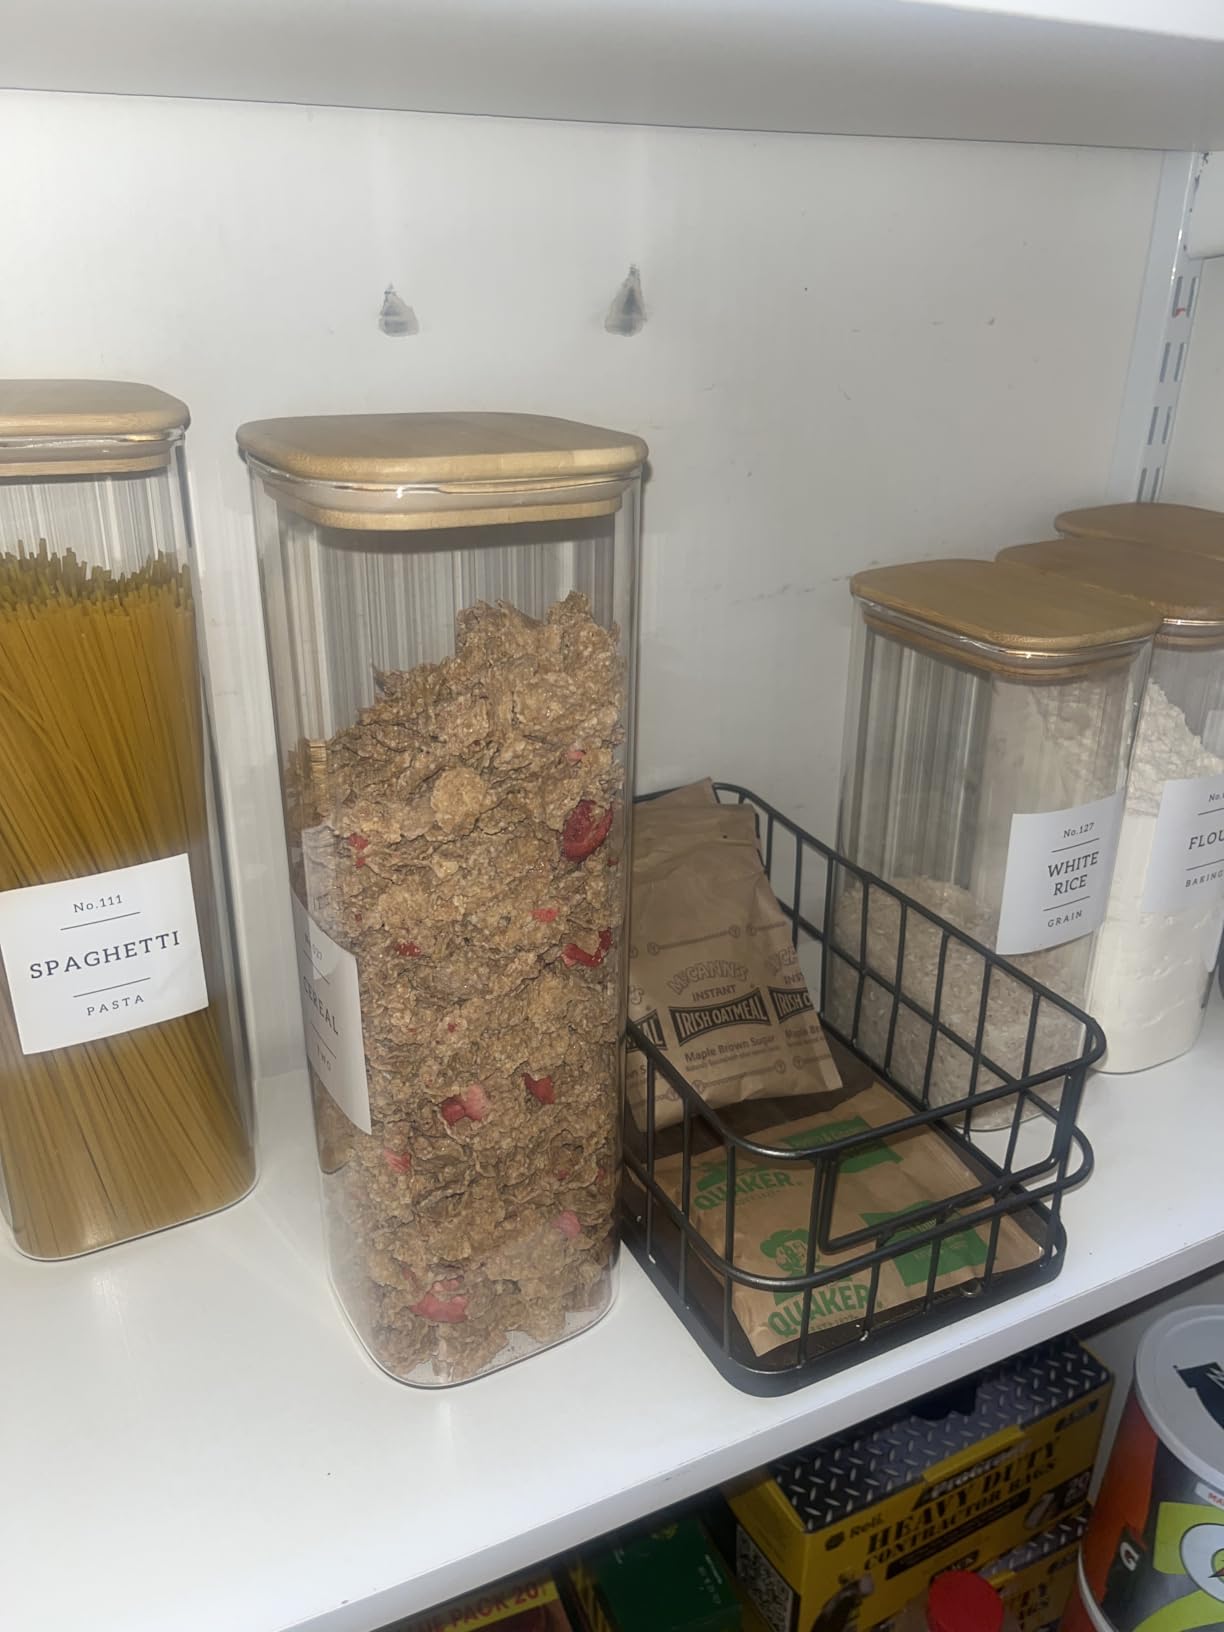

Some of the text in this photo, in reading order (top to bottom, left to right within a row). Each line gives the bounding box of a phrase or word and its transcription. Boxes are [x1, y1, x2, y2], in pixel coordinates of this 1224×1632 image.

[1063, 822, 1095, 838] No.127
[1047, 851, 1099, 877] WHITE
[1053, 874, 1088, 896] RICE
[73, 894, 123, 913] No.111
[1047, 910, 1083, 928] GRAIN
[29, 931, 181, 979] SPAGHETTI
[692, 984, 737, 1002] INSTANT
[87, 994, 144, 1016] PASTA
[676, 1010, 712, 1039] IRISH
[713, 995, 768, 1026] OATMEAL
[684, 1046, 717, 1063] Maple
[718, 1039, 749, 1055] Brown
[867, 1484, 972, 1555] HEAVY
[981, 1438, 1056, 1493] DUTY
[864, 1491, 1001, 1570] CONTRACTOR
